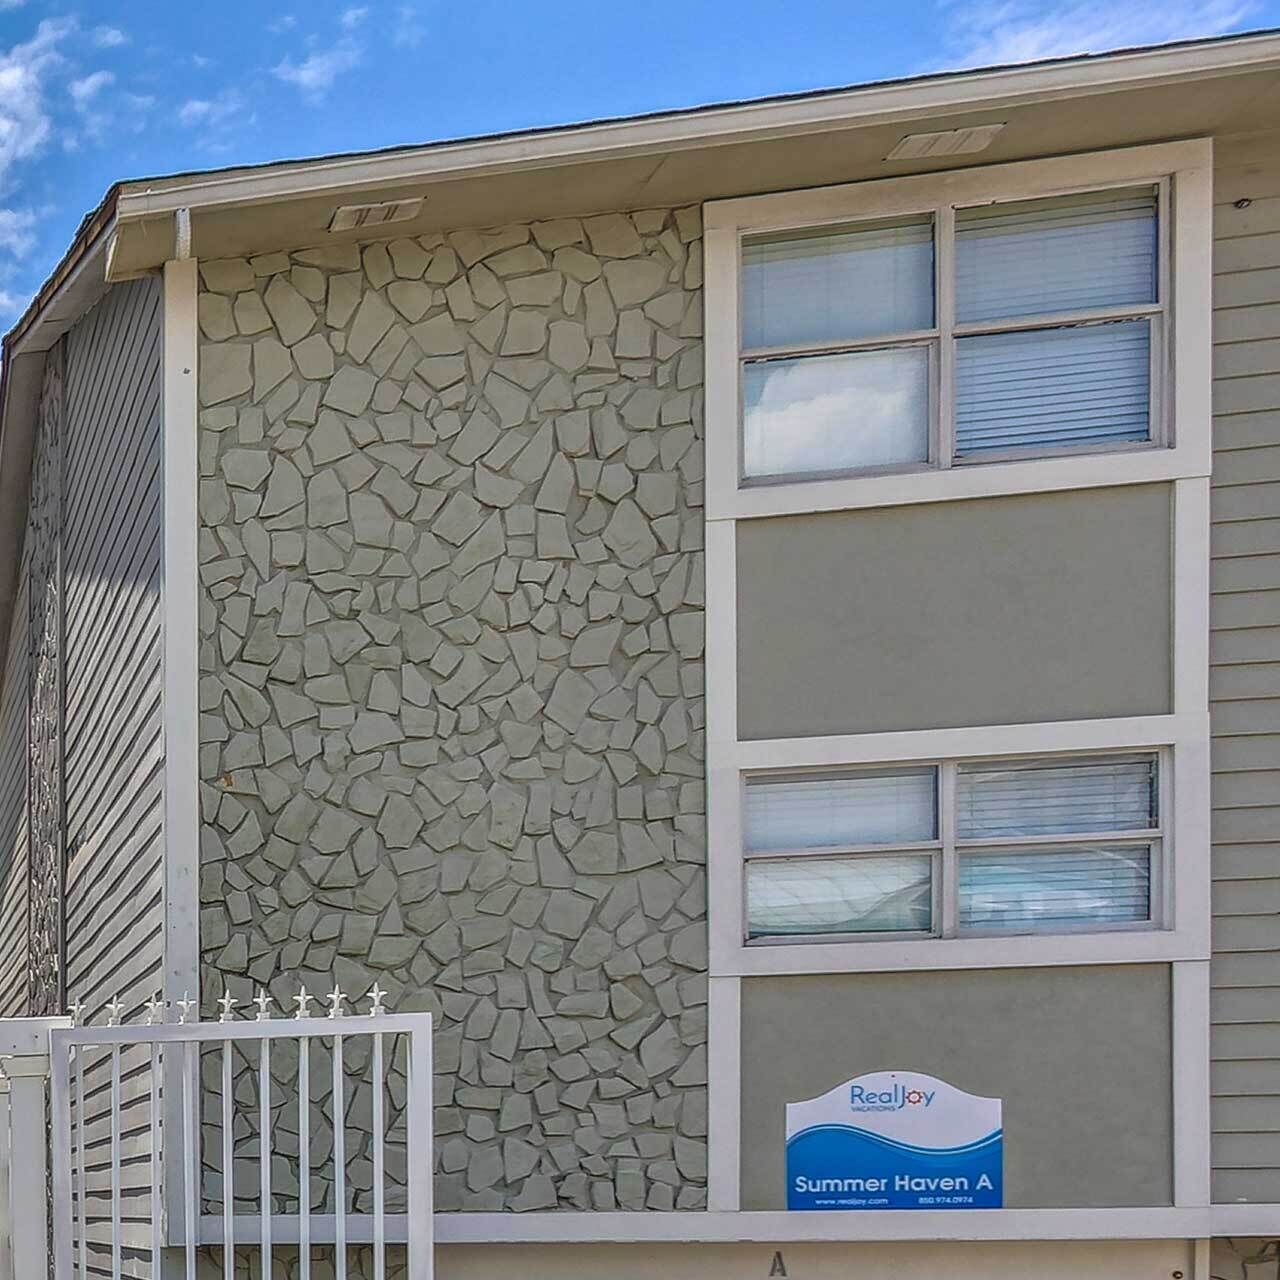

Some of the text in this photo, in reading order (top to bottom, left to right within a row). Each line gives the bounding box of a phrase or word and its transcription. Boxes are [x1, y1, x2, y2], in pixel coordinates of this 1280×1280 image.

[851, 1084, 936, 1108] RealJoy
[795, 1174, 993, 1193] Summer Haven A
[769, 1251, 788, 1277] A
